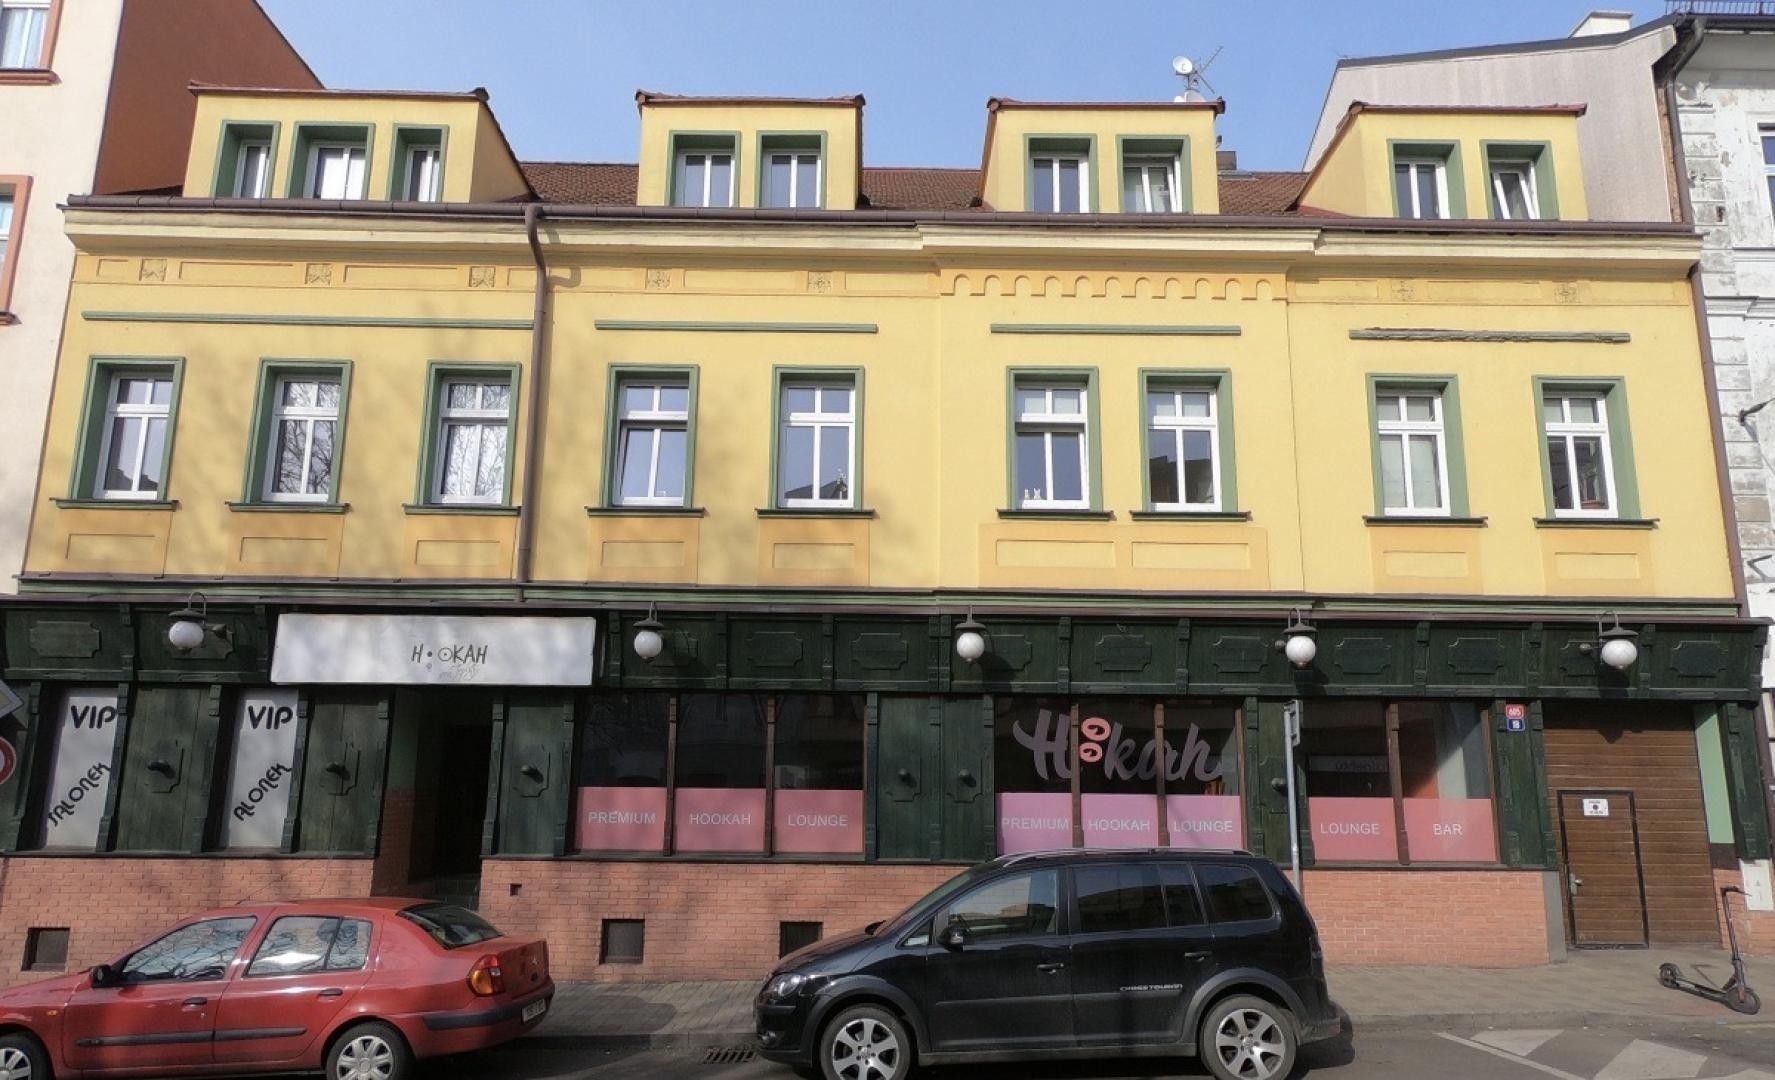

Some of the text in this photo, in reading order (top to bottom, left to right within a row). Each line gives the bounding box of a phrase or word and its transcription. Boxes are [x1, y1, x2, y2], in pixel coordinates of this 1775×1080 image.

[70, 705, 117, 729] VIP
[248, 706, 294, 730] VIP
[233, 763, 293, 821] ALONEK
[588, 811, 849, 827] PREMIUM HOOKAH LOUNGE
[1002, 817, 1233, 833] PREMIUM HOOKAH LOUNGE
[1320, 823, 1464, 836] LOUNGE BAR
